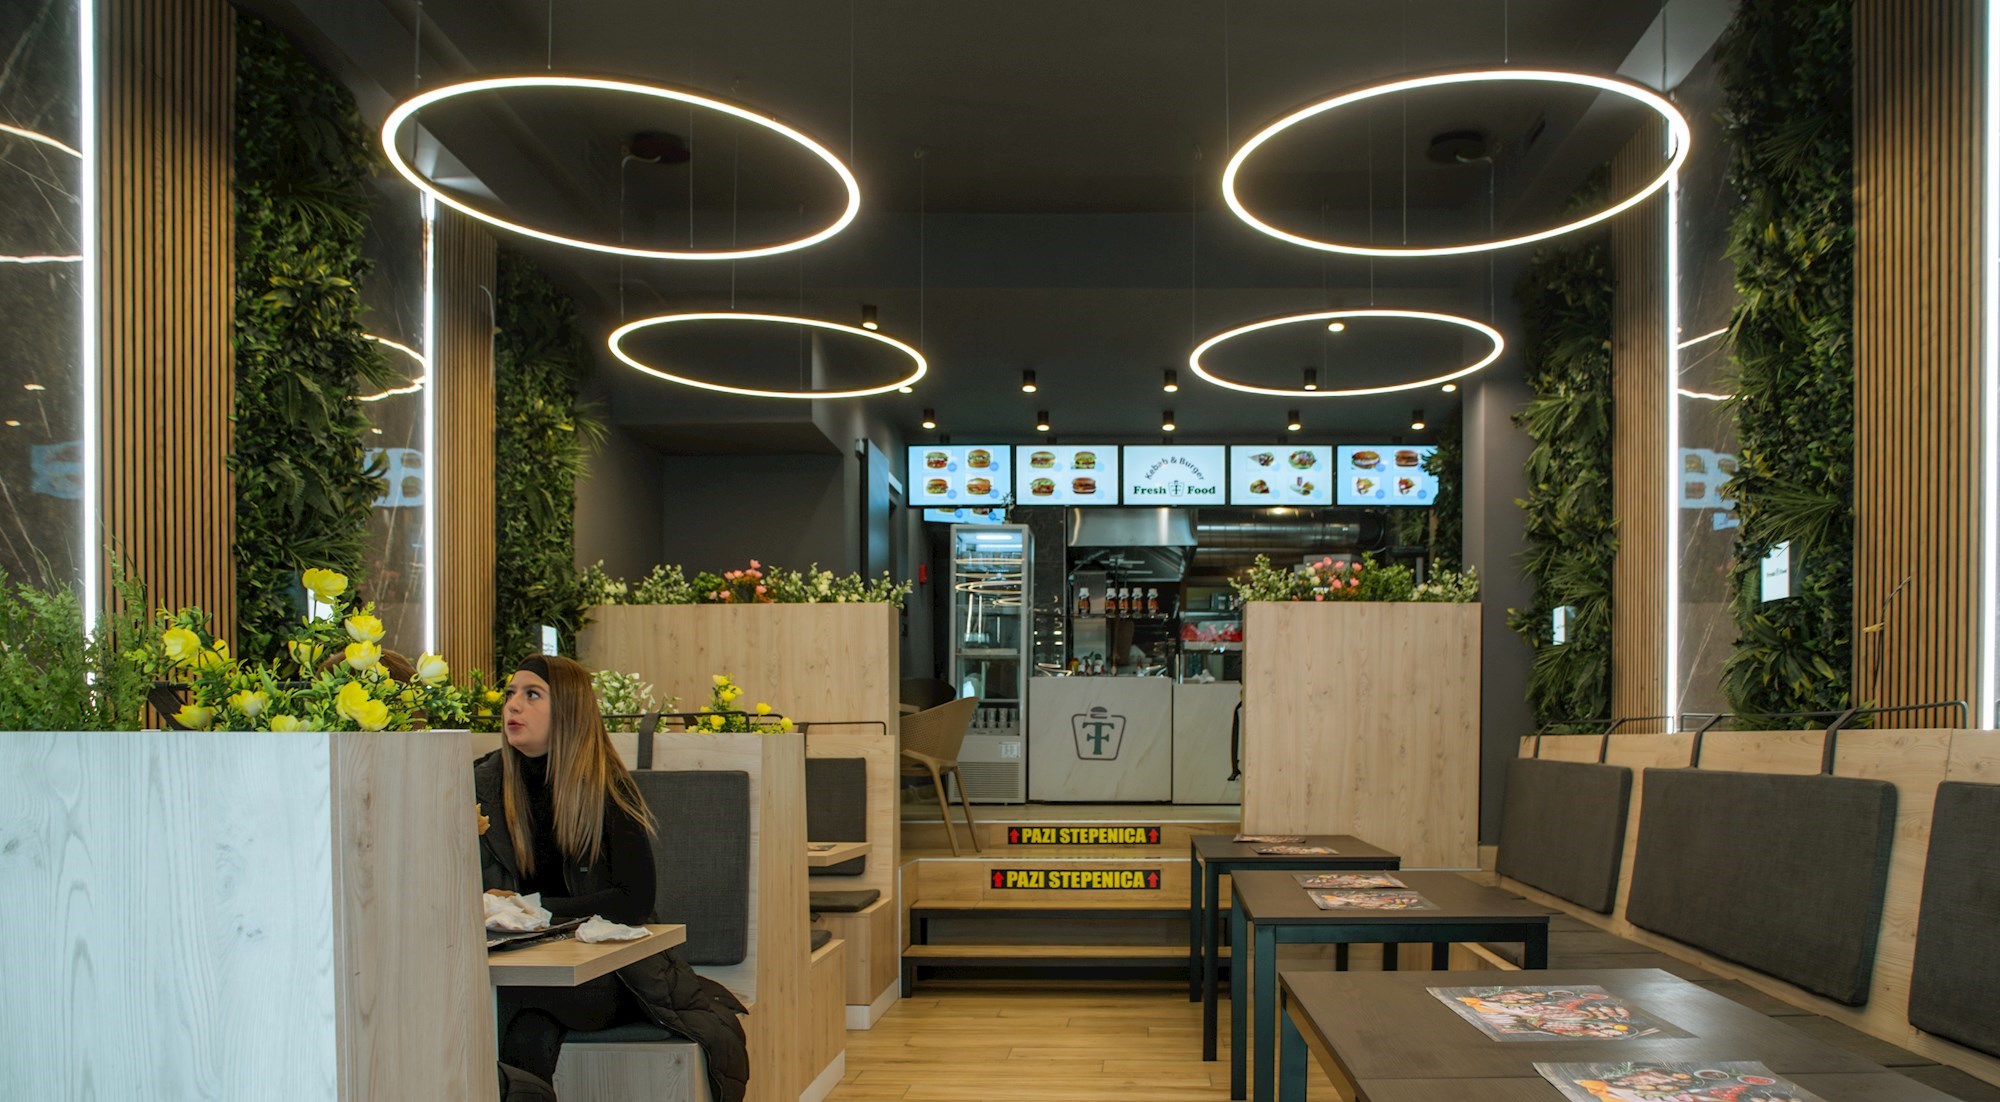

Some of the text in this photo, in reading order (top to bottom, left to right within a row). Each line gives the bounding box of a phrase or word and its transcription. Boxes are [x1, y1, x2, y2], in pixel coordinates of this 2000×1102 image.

[1145, 456, 1204, 480] Kebab & Burger
[1133, 485, 1166, 495] Fresh
[1187, 485, 1216, 495] Food
[1021, 828, 1147, 844] PAZI STEPENICA
[1006, 871, 1146, 888] PAZI STEPENICA
